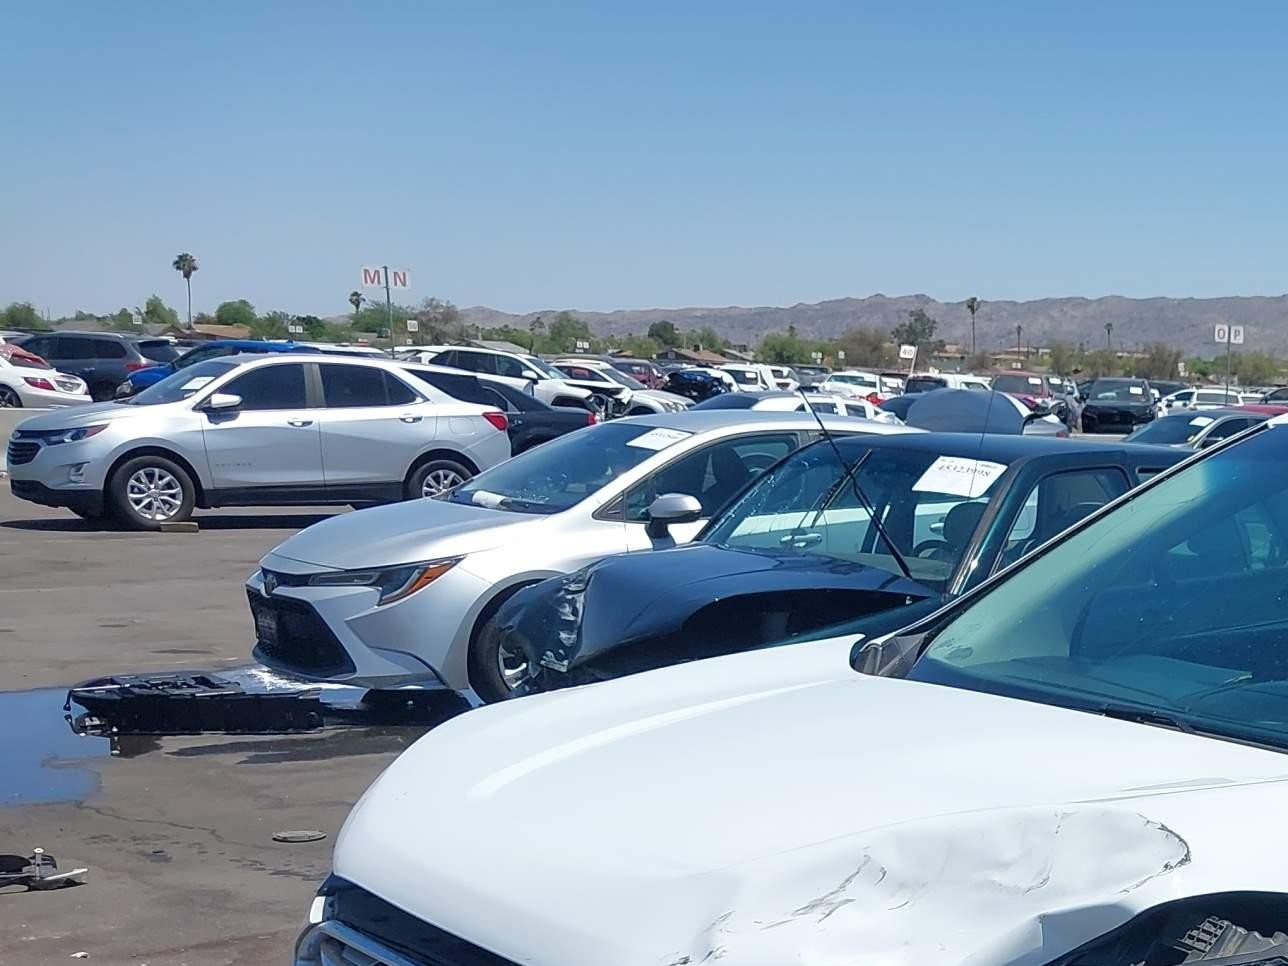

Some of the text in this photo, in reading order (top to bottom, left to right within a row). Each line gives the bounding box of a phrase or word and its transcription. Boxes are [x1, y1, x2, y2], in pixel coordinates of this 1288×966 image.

[363, 268, 381, 285] M
[393, 271, 406, 287] N
[1234, 329, 1241, 341] P
